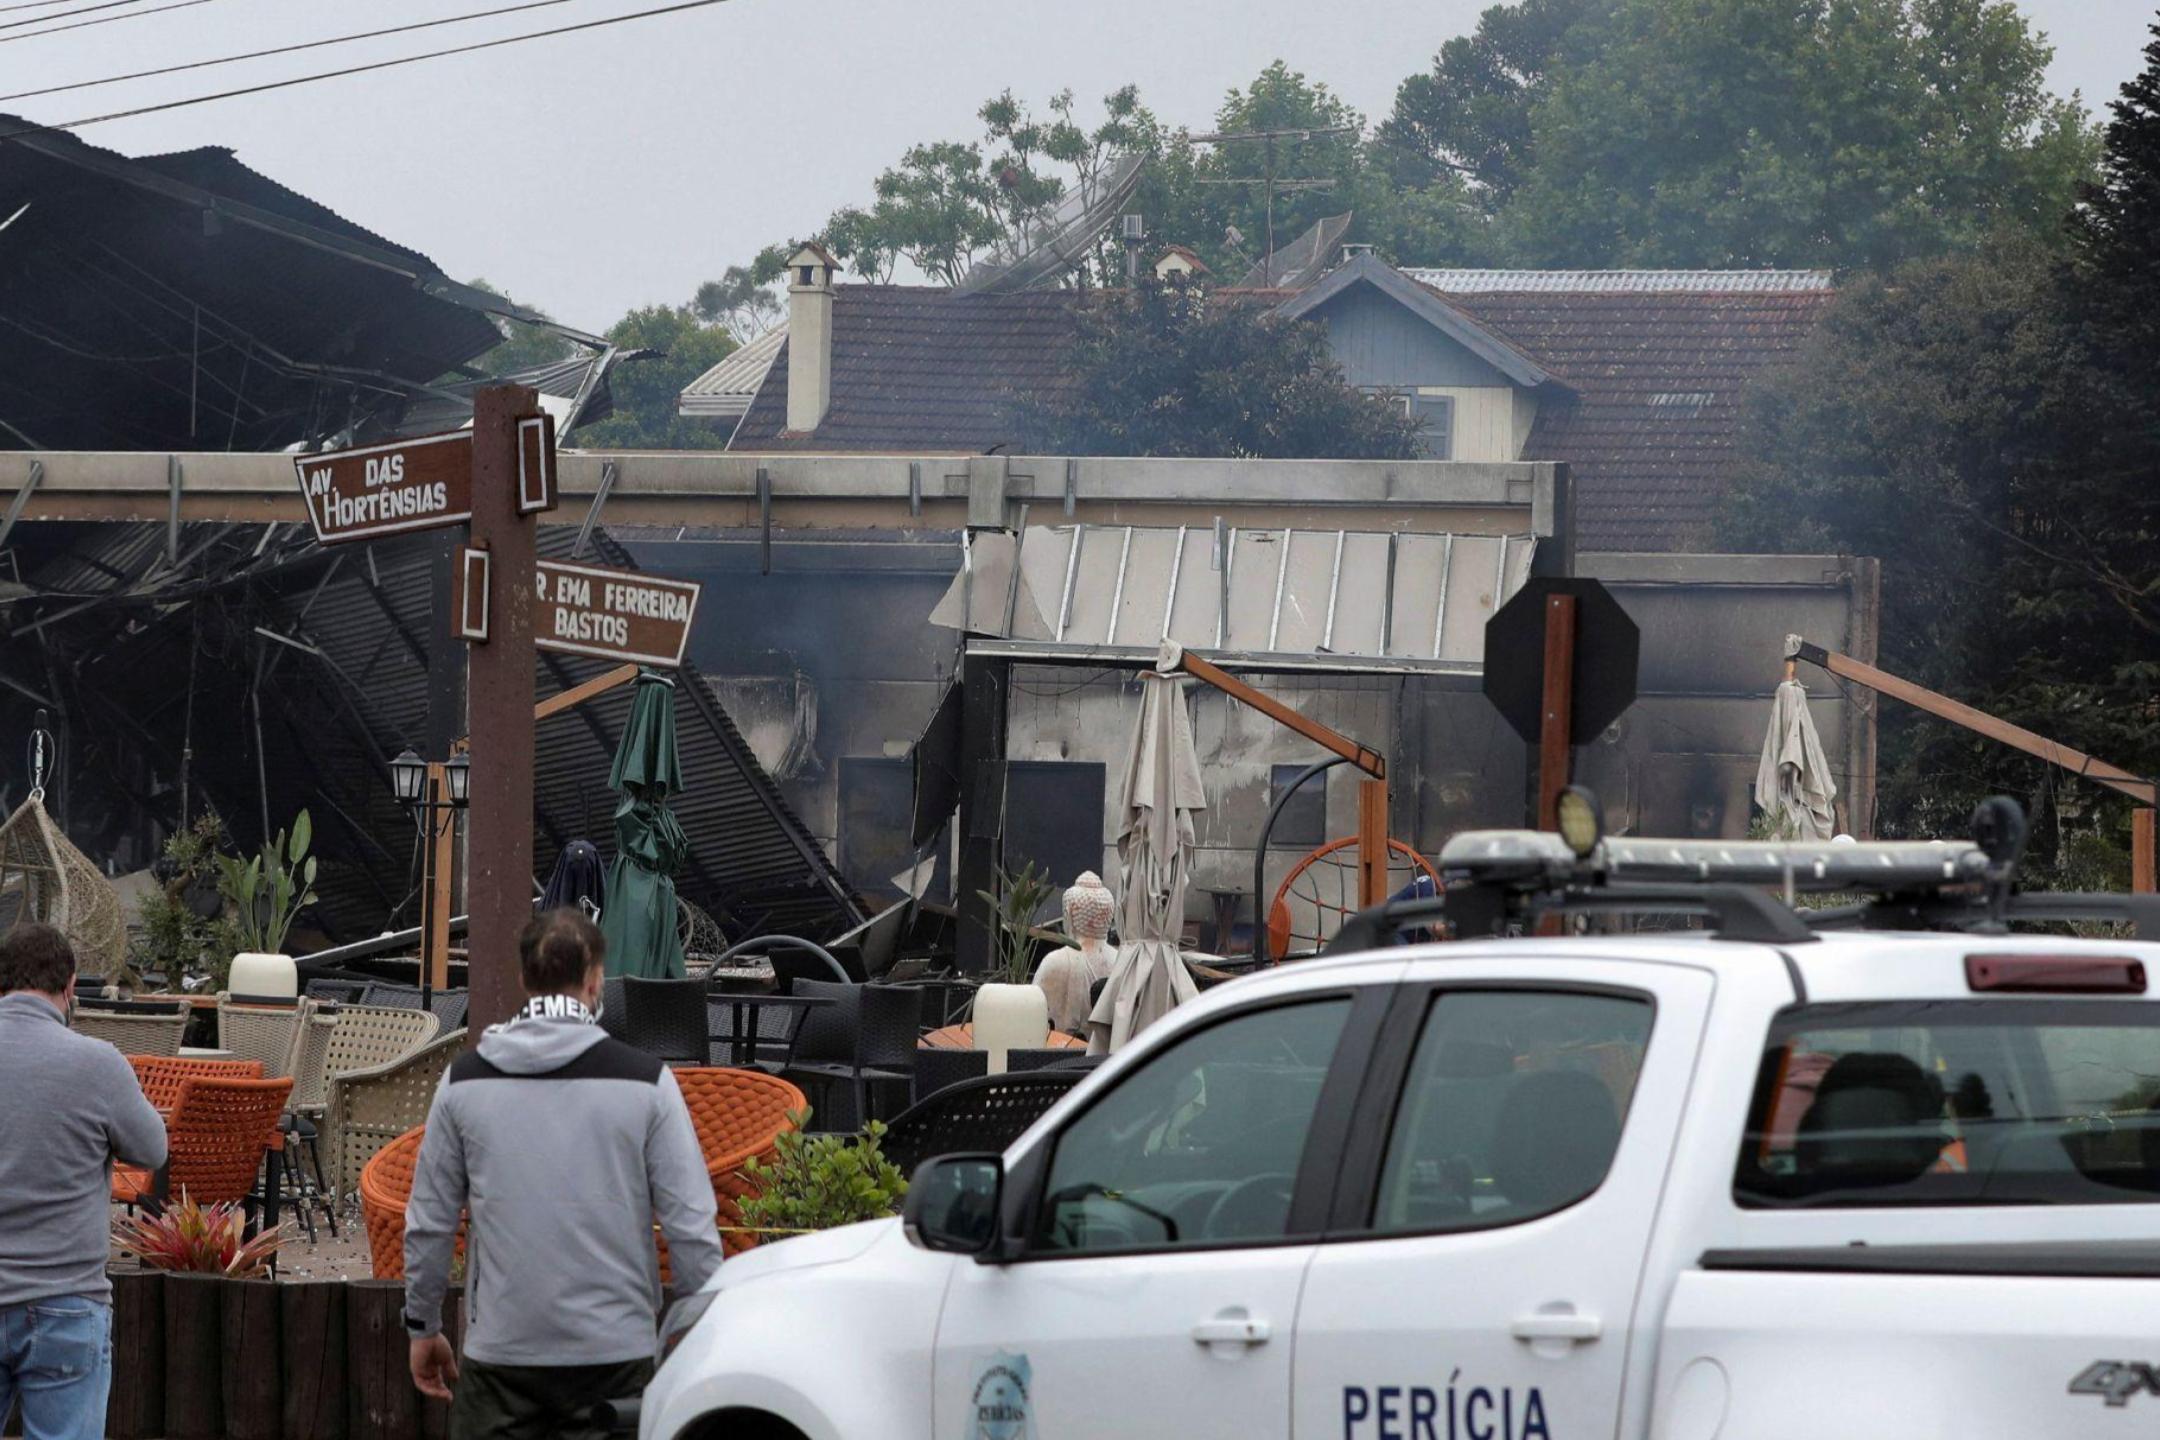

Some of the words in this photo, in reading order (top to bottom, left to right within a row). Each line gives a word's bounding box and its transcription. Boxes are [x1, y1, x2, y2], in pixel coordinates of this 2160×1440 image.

[310, 467, 337, 496] AV.
[365, 453, 405, 487] DAS
[323, 481, 448, 529] HORTÊNSIAS
[557, 575, 591, 608] EMA
[604, 583, 688, 622] FERREIRA
[555, 607, 628, 647] BASTOS
[1342, 1366, 1552, 1440] PERÍCIA
